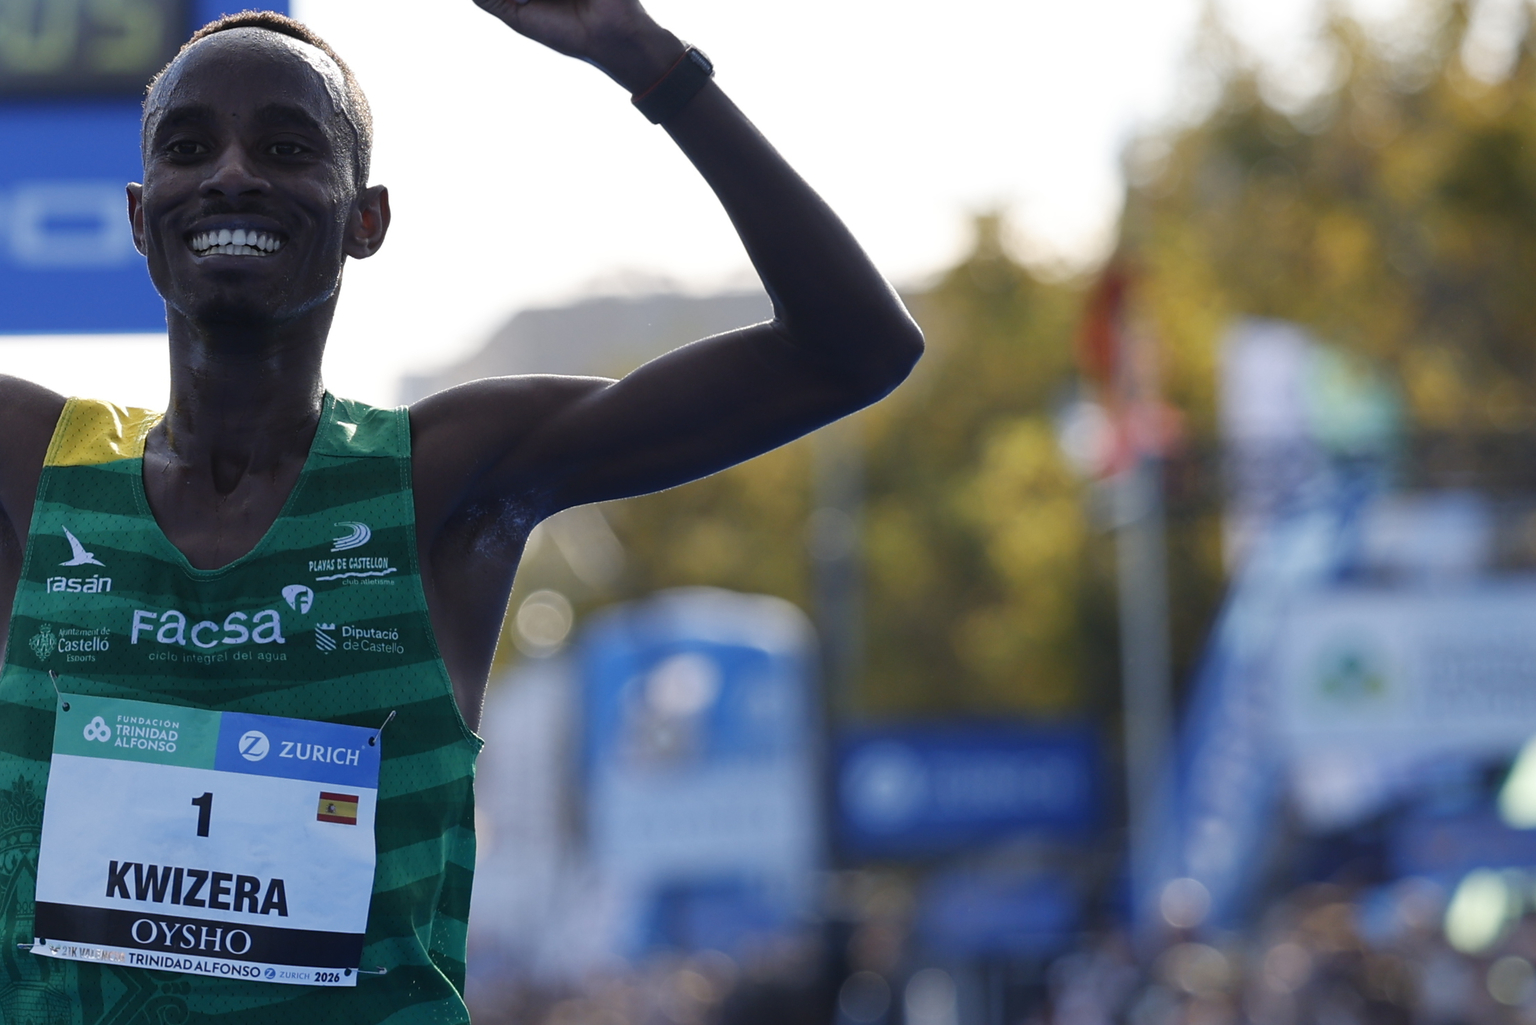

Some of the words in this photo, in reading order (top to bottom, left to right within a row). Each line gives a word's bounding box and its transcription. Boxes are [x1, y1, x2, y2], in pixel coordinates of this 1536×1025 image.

[309, 559, 335, 572] PLAYAS
[337, 558, 347, 570] DE
[349, 557, 389, 570] CASTELLON
[46, 574, 112, 594] rasán
[342, 578, 359, 586] club
[100, 627, 111, 635] de
[342, 625, 399, 641] Diputació
[58, 636, 110, 653] Castelló
[343, 639, 359, 650] de
[361, 640, 404, 654] Castelló
[66, 654, 96, 662] Esports
[148, 651, 178, 661] ciclo
[183, 652, 228, 665] integral
[232, 651, 253, 661] del
[257, 652, 287, 663] agua
[117, 715, 180, 729] FUNDACIÓN
[115, 724, 178, 741] TRINIDAD
[114, 737, 177, 753] ALFONSO
[279, 741, 360, 766] ZURICH
[191, 792, 213, 838] 1
[105, 860, 289, 917] KWIZERA
[130, 919, 252, 956] OYSHO
[128, 953, 193, 970] TRINIDAD
[194, 960, 261, 977] ALFONSO
[279, 971, 310, 980] ZURICH
[314, 972, 340, 983] 2026
